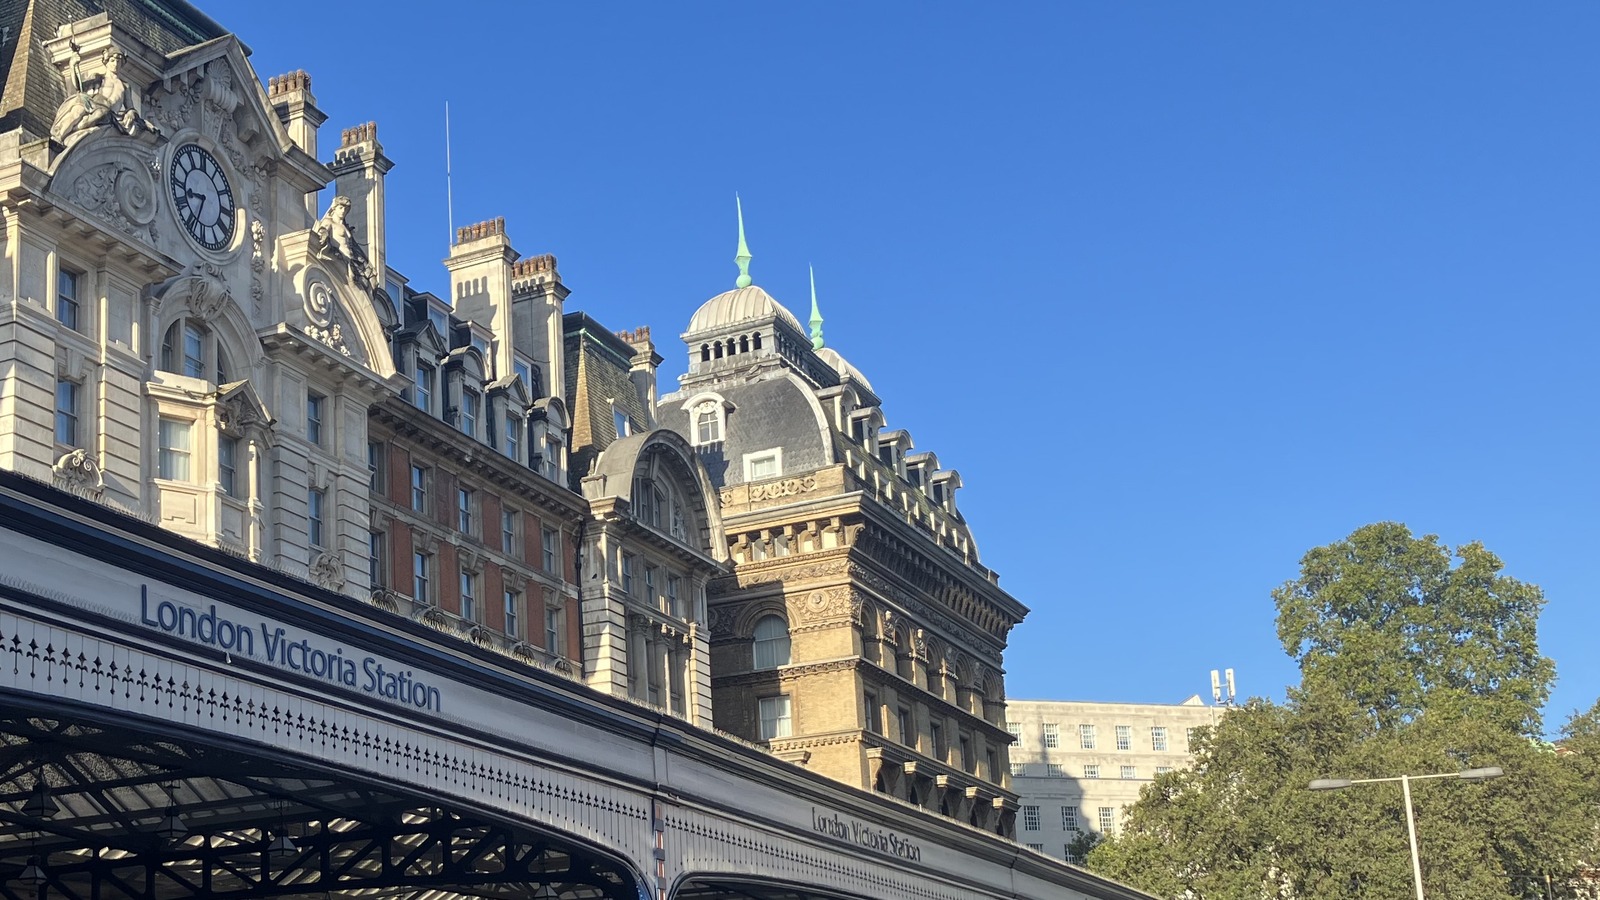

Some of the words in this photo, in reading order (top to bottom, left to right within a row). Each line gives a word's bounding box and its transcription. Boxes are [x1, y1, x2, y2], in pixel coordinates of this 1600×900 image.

[141, 584, 253, 655] London
[261, 622, 356, 686] Victoria
[363, 657, 441, 712] Station
[812, 806, 851, 841] London
[851, 820, 888, 853] Victoria
[889, 832, 921, 862] Station
